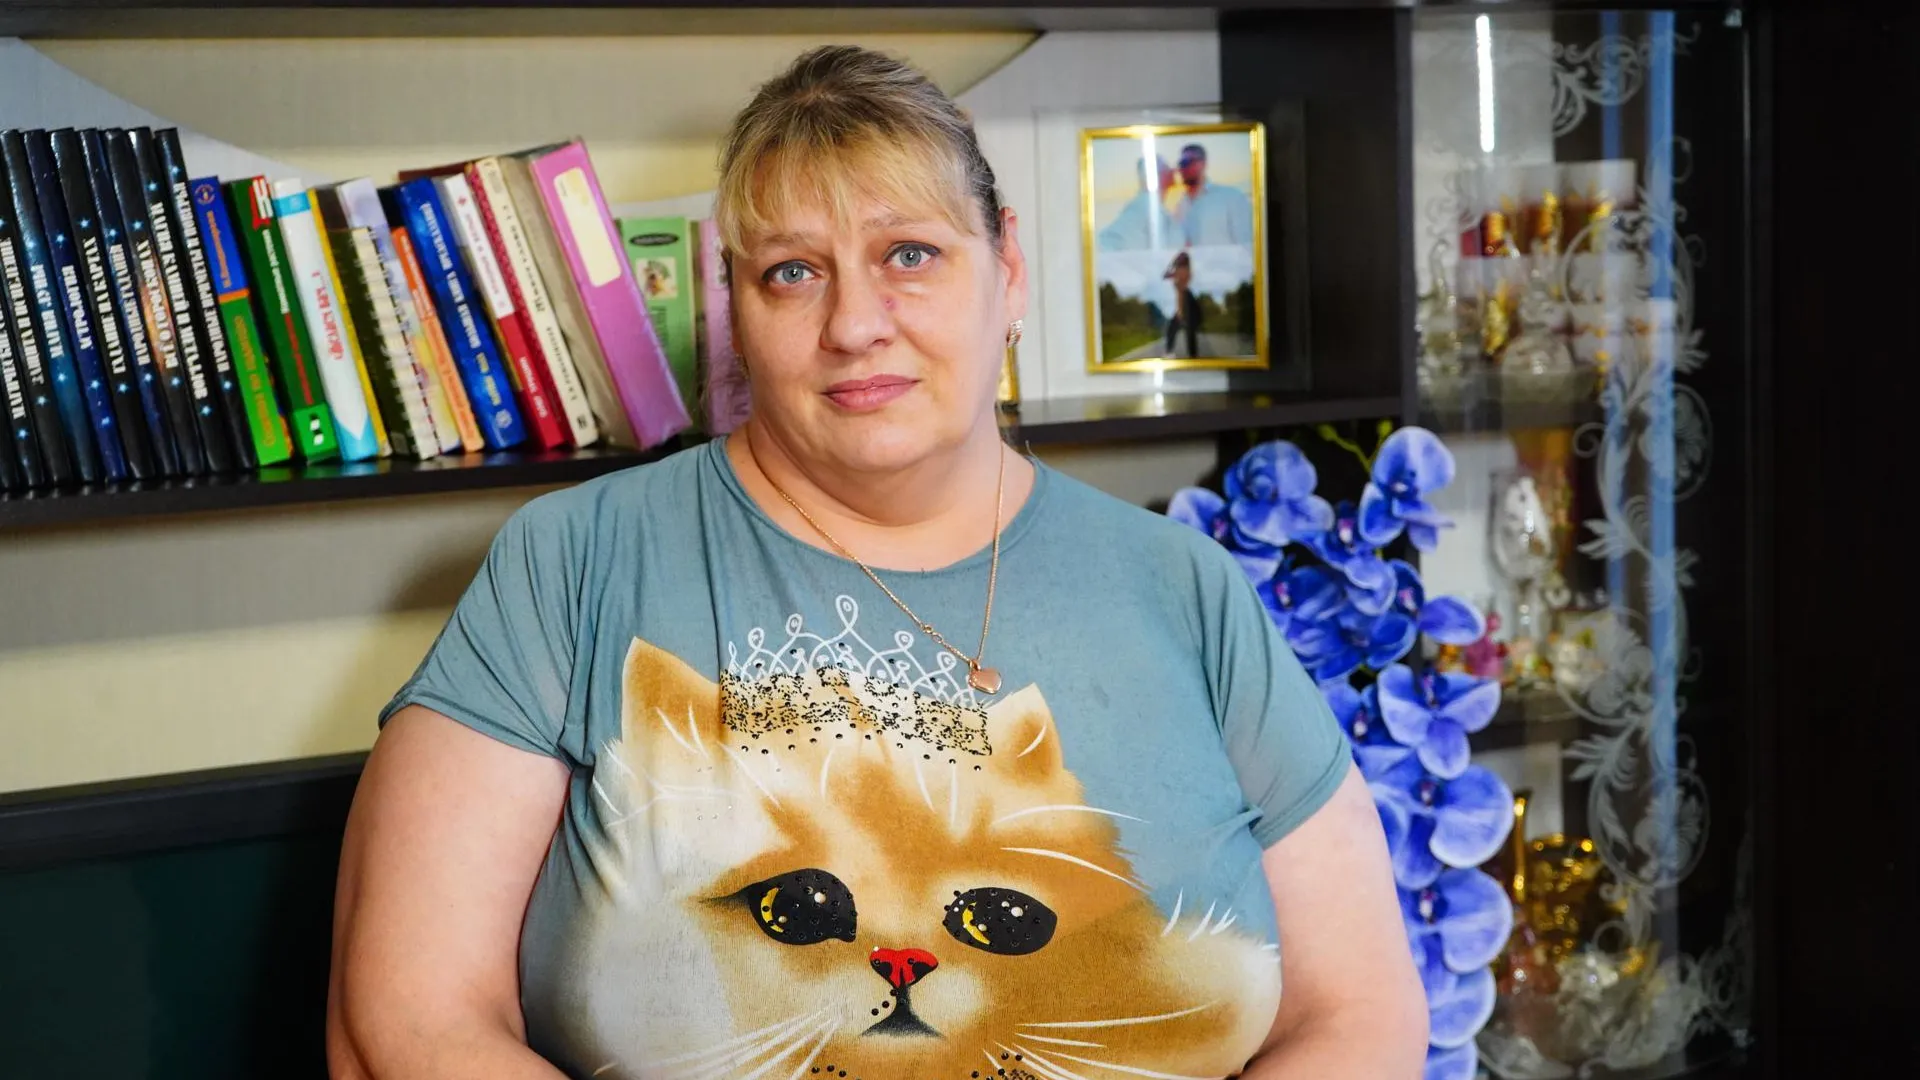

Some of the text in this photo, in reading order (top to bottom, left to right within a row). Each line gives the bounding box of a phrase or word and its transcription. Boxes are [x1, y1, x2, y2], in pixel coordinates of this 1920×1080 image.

[172, 181, 197, 238] ПОВЕРЬЯ
[185, 236, 199, 248] И
[0, 236, 44, 383] ЗАЩИТА И ИСЦЕЛЕНИЕ
[29, 263, 64, 358] МАГИЯ ЛУНЫ
[61, 264, 93, 349] АСТРОЛОГИЯ
[82, 236, 126, 373] ГАДАНИЕ НА КАРТАХ
[107, 243, 150, 365] НАРОДНЫЕ ГАДАНИЯ
[136, 239, 171, 331] ГОРОСКОПАХ
[148, 201, 208, 399] МАГИЯ КАМНЕЙ И МЕТАЛЛОВ
[189, 248, 214, 308] ПРИМЕТЫ
[154, 329, 171, 343] О
[203, 307, 230, 372] НАРОДНЫЕ
